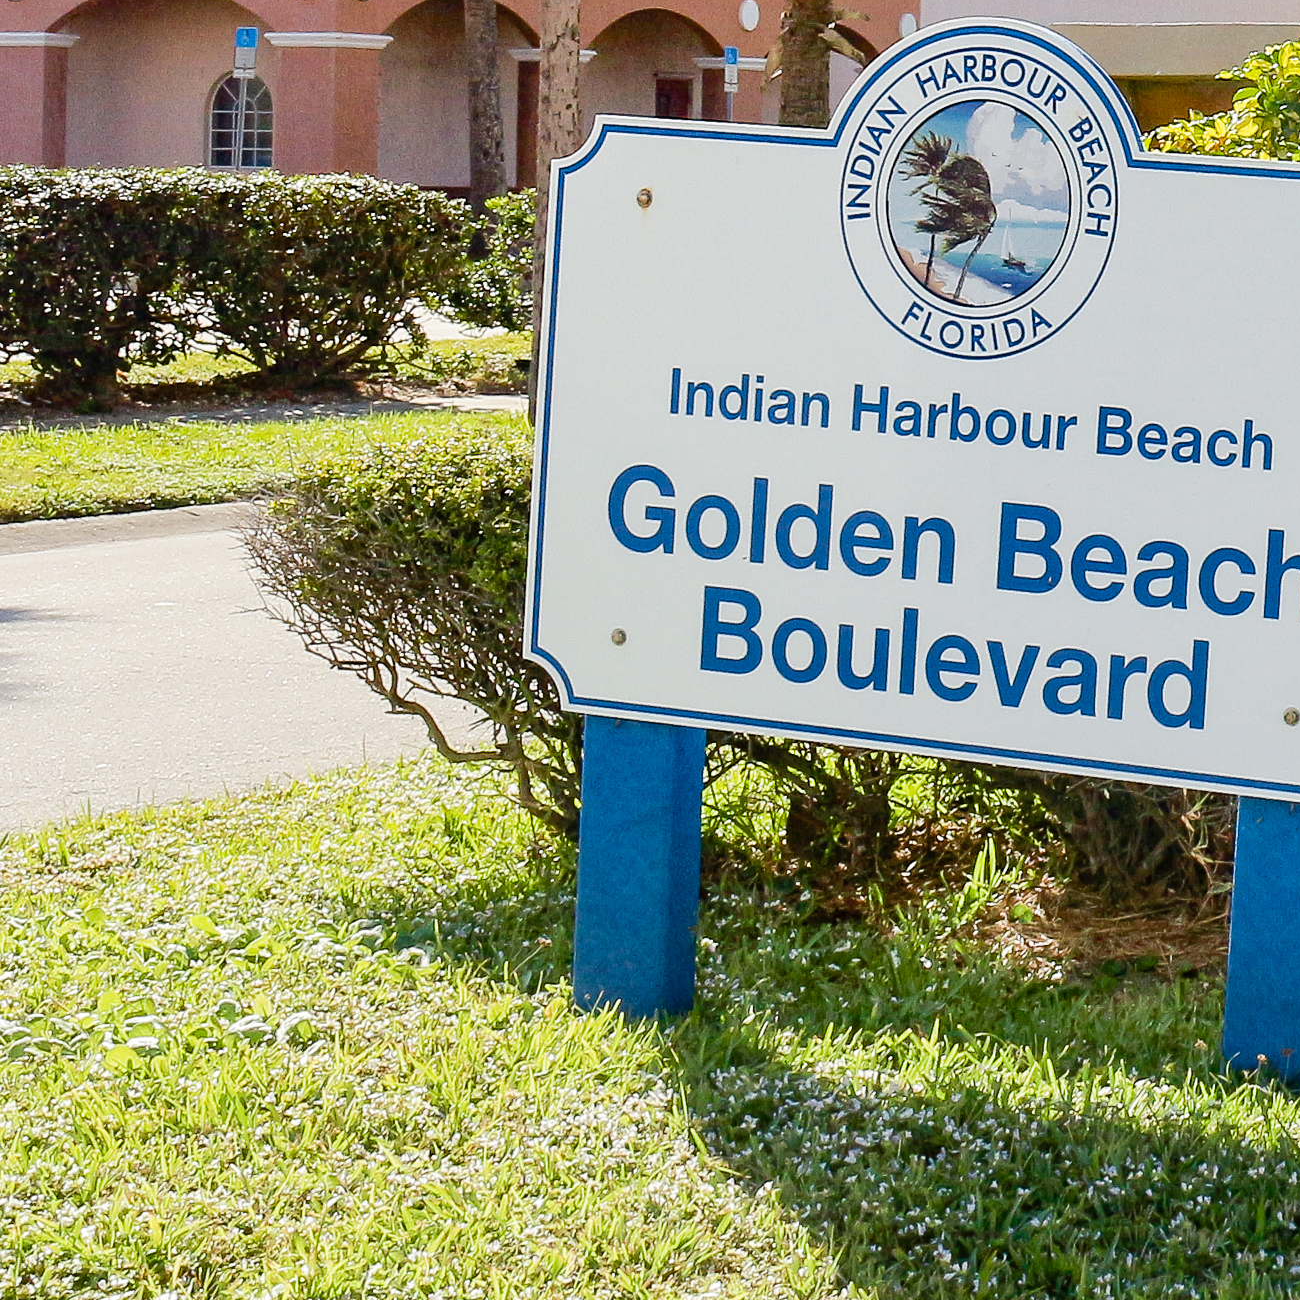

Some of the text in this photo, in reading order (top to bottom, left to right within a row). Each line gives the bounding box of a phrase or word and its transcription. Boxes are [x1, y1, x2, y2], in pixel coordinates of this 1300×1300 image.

[846, 54, 1113, 238] INDIAN HARBOUR BEACH
[901, 301, 1053, 352] FLORIDA
[669, 367, 1273, 471] Indian Harbour Beach
[607, 464, 956, 585] Golden
[699, 585, 1210, 730] Boulevard
